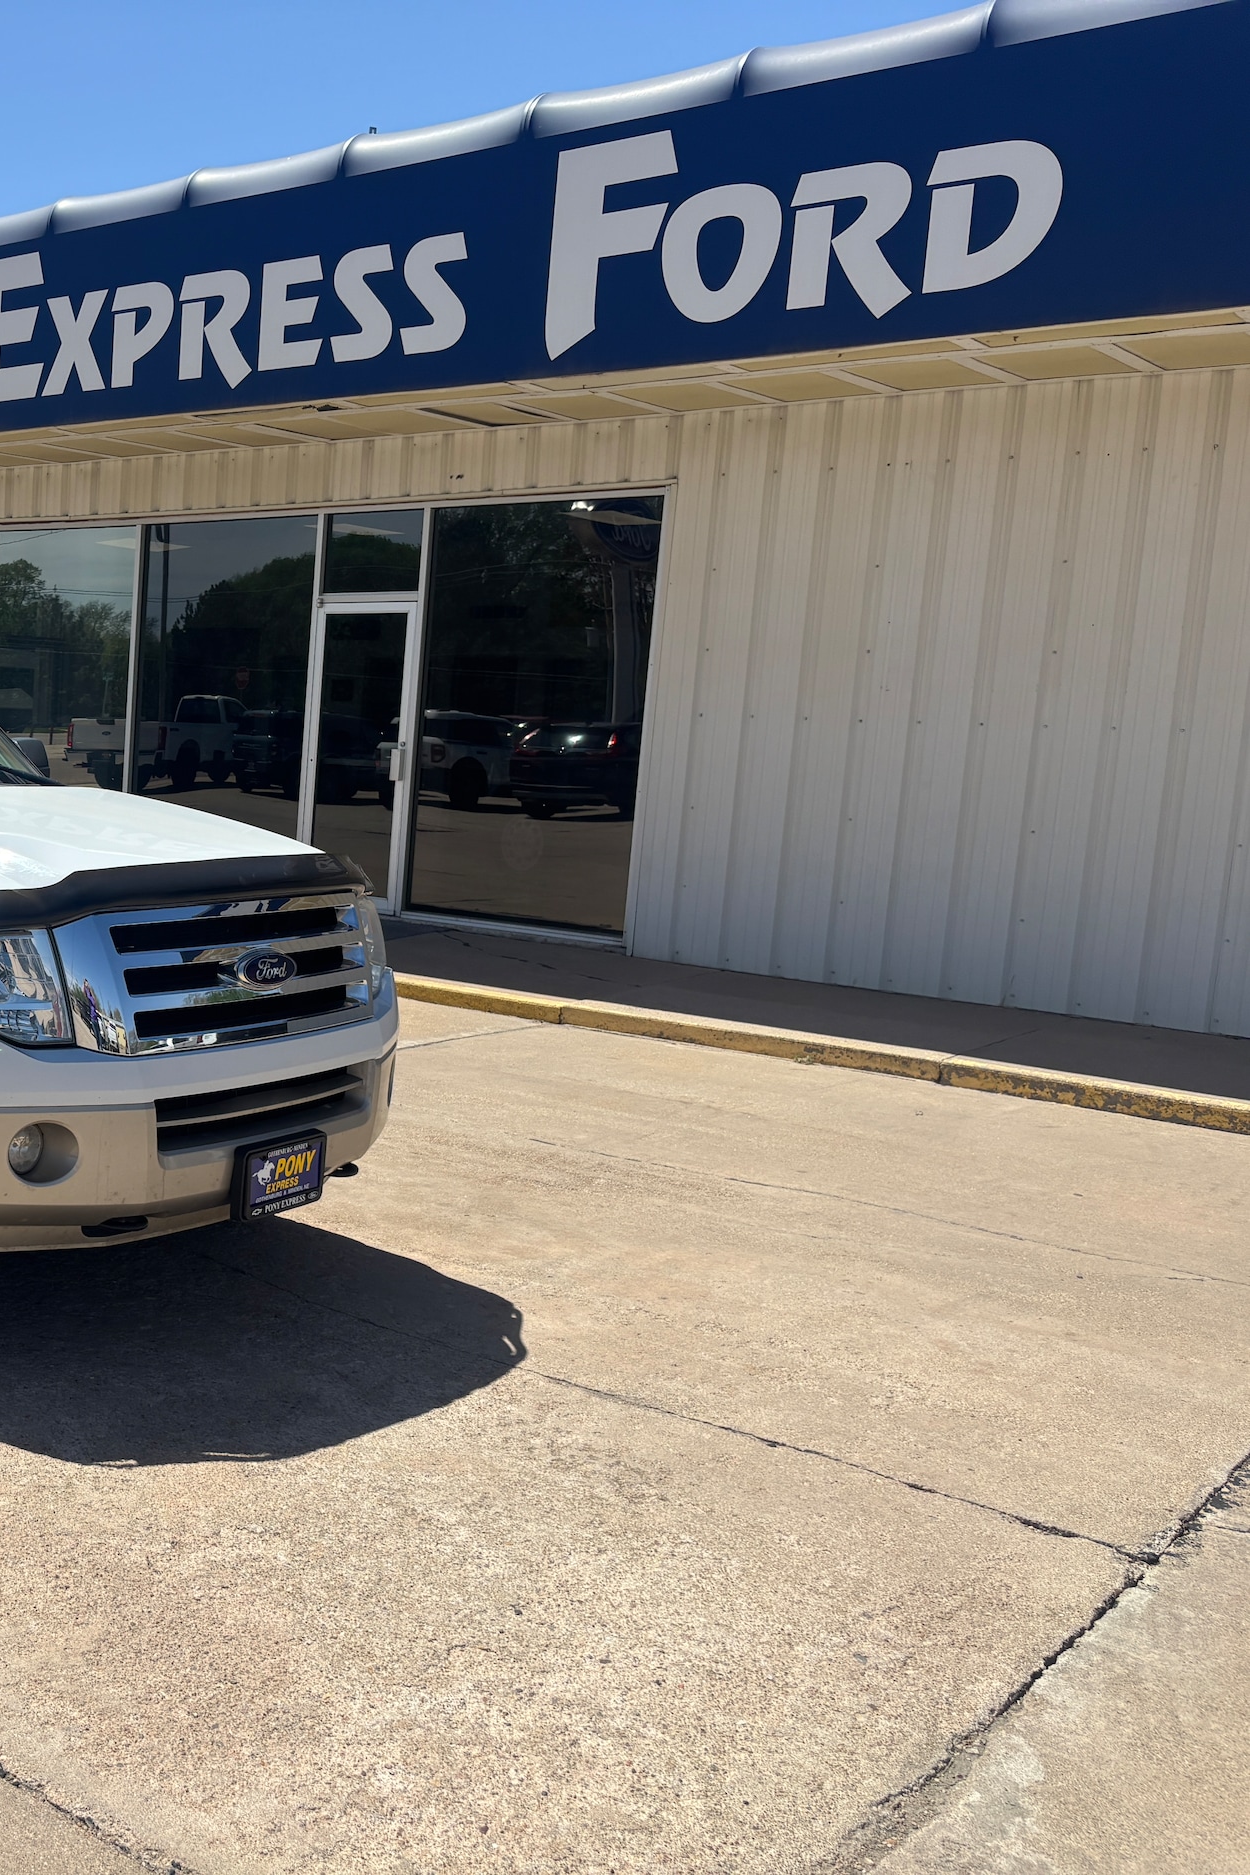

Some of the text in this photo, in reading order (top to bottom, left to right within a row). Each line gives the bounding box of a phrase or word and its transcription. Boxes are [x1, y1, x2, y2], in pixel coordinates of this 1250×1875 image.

[256, 958, 287, 981] Ford
[275, 1149, 316, 1180] PONY
[266, 1176, 299, 1194] EXPRESS
[265, 1201, 281, 1213] PONY
[281, 1194, 306, 1208] EXPRESS
